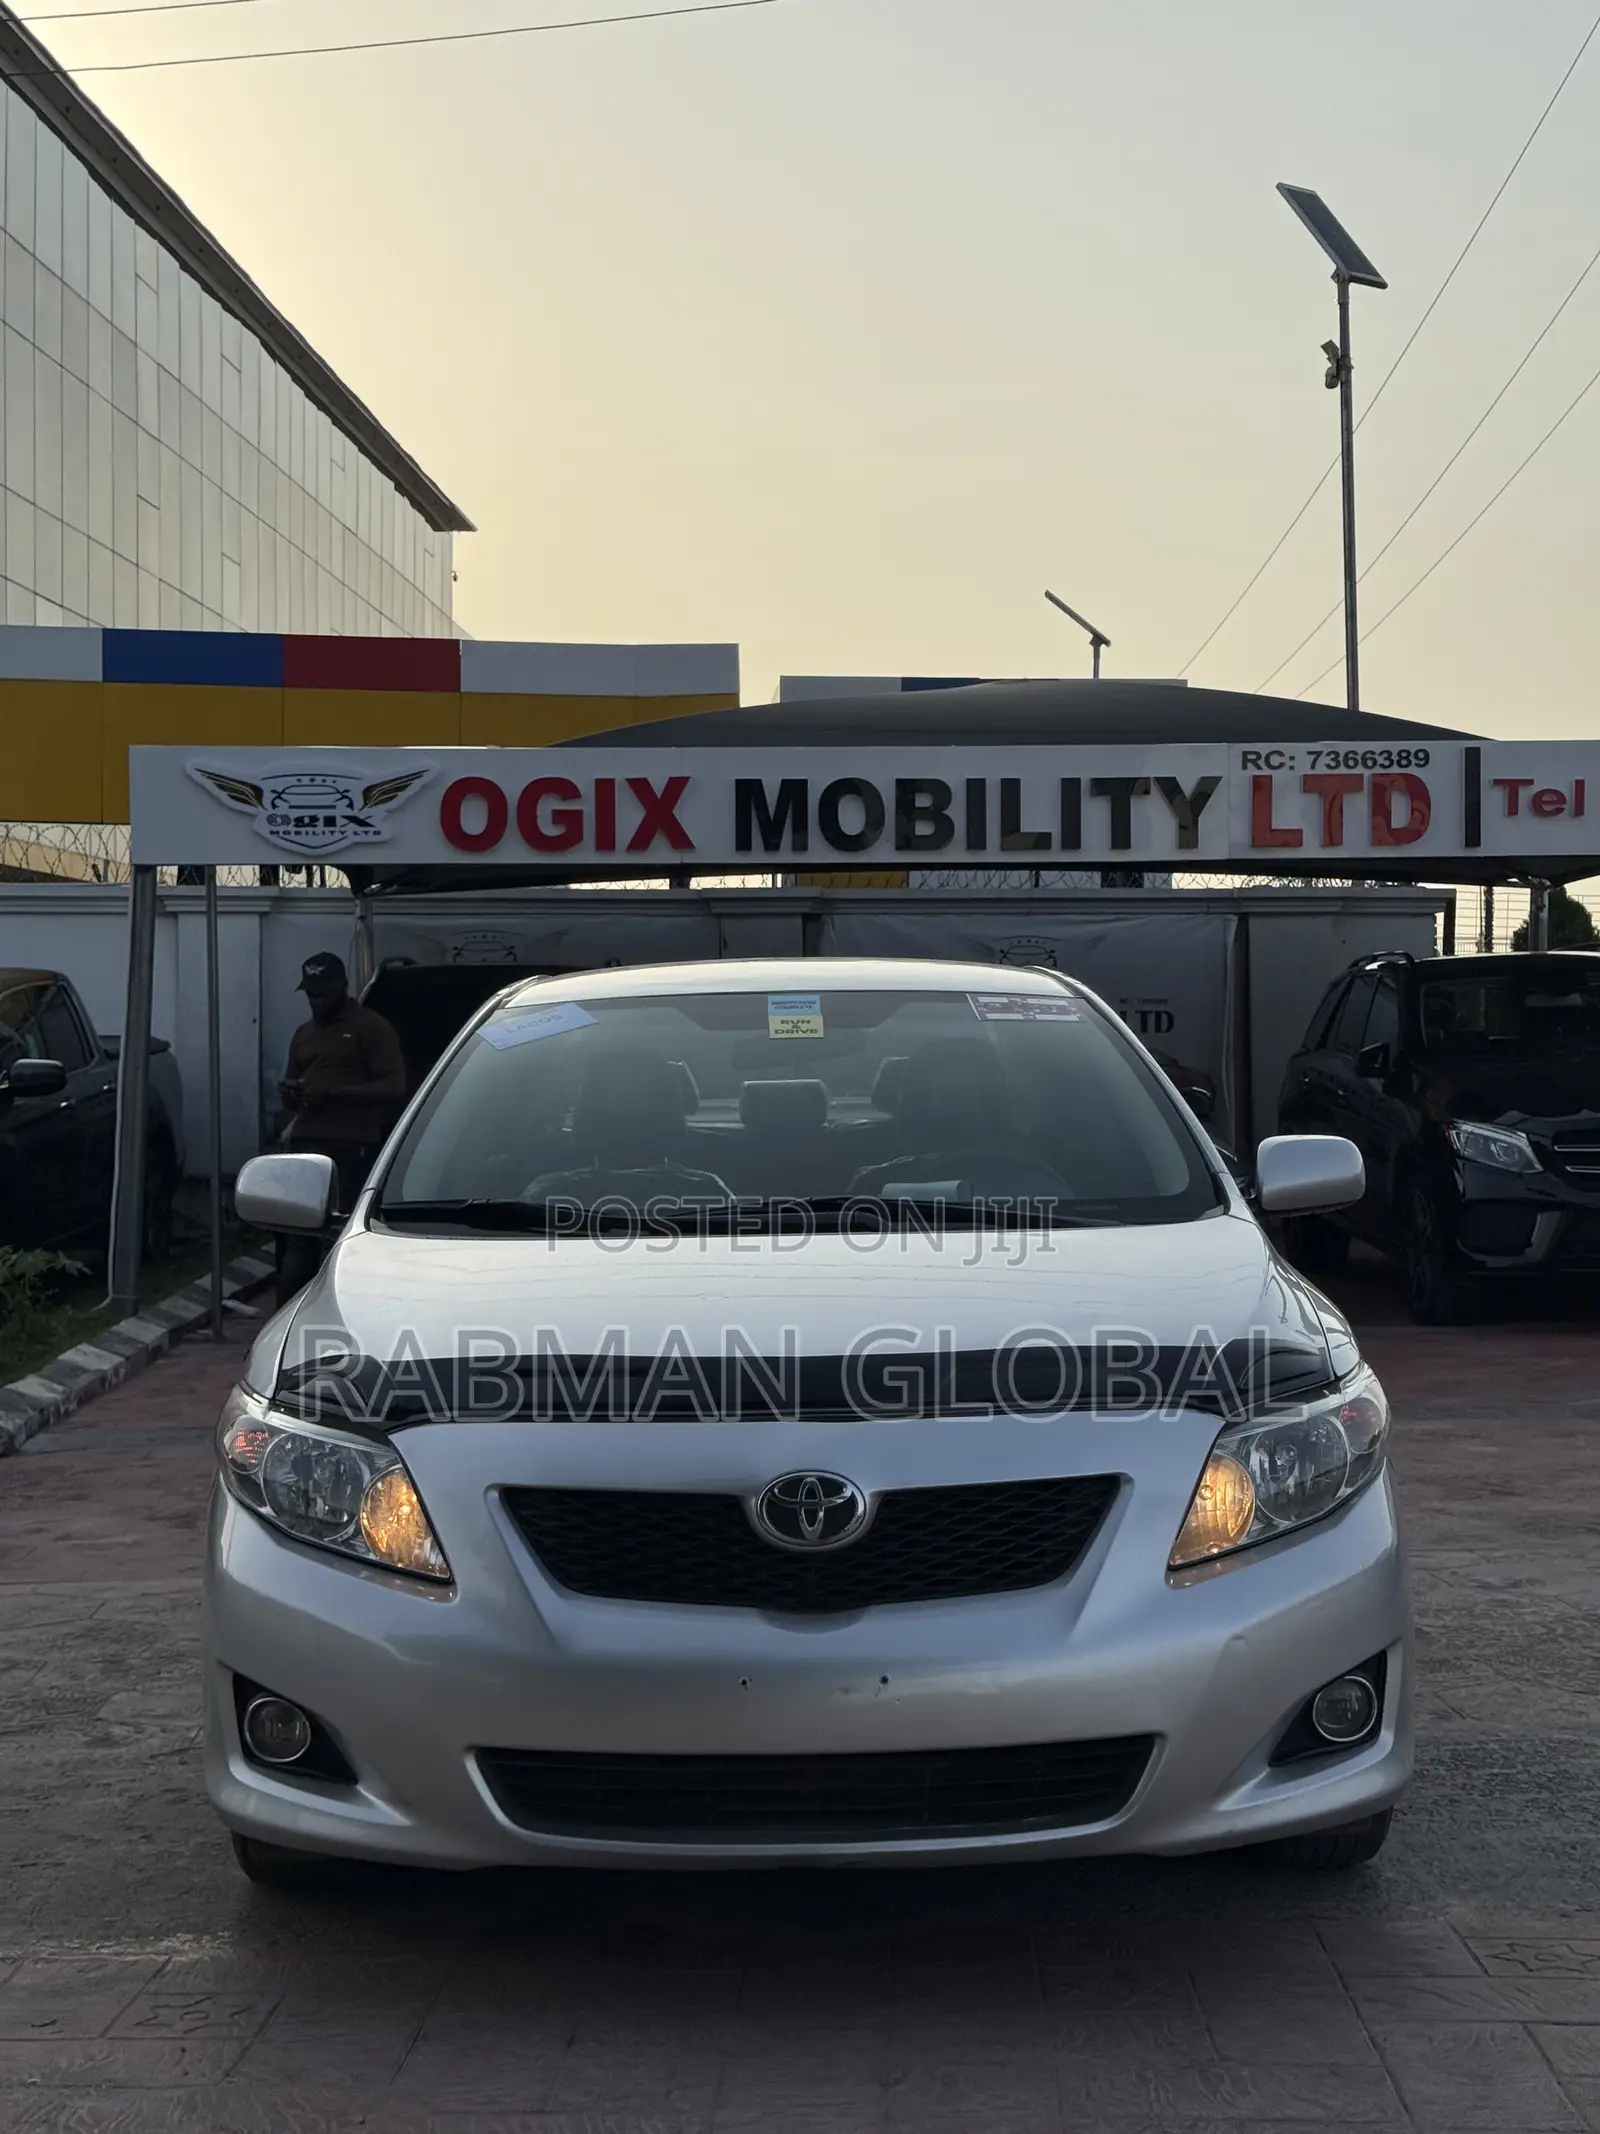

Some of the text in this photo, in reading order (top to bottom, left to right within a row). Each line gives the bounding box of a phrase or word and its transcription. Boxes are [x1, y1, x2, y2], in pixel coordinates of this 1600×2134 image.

[1241, 748, 1431, 772] RC: 7366389
[439, 773, 1432, 853] OGIX MOBILITY LTD
[1490, 777, 1587, 819] Tel
[269, 829, 383, 837] MOBILITY LTD
